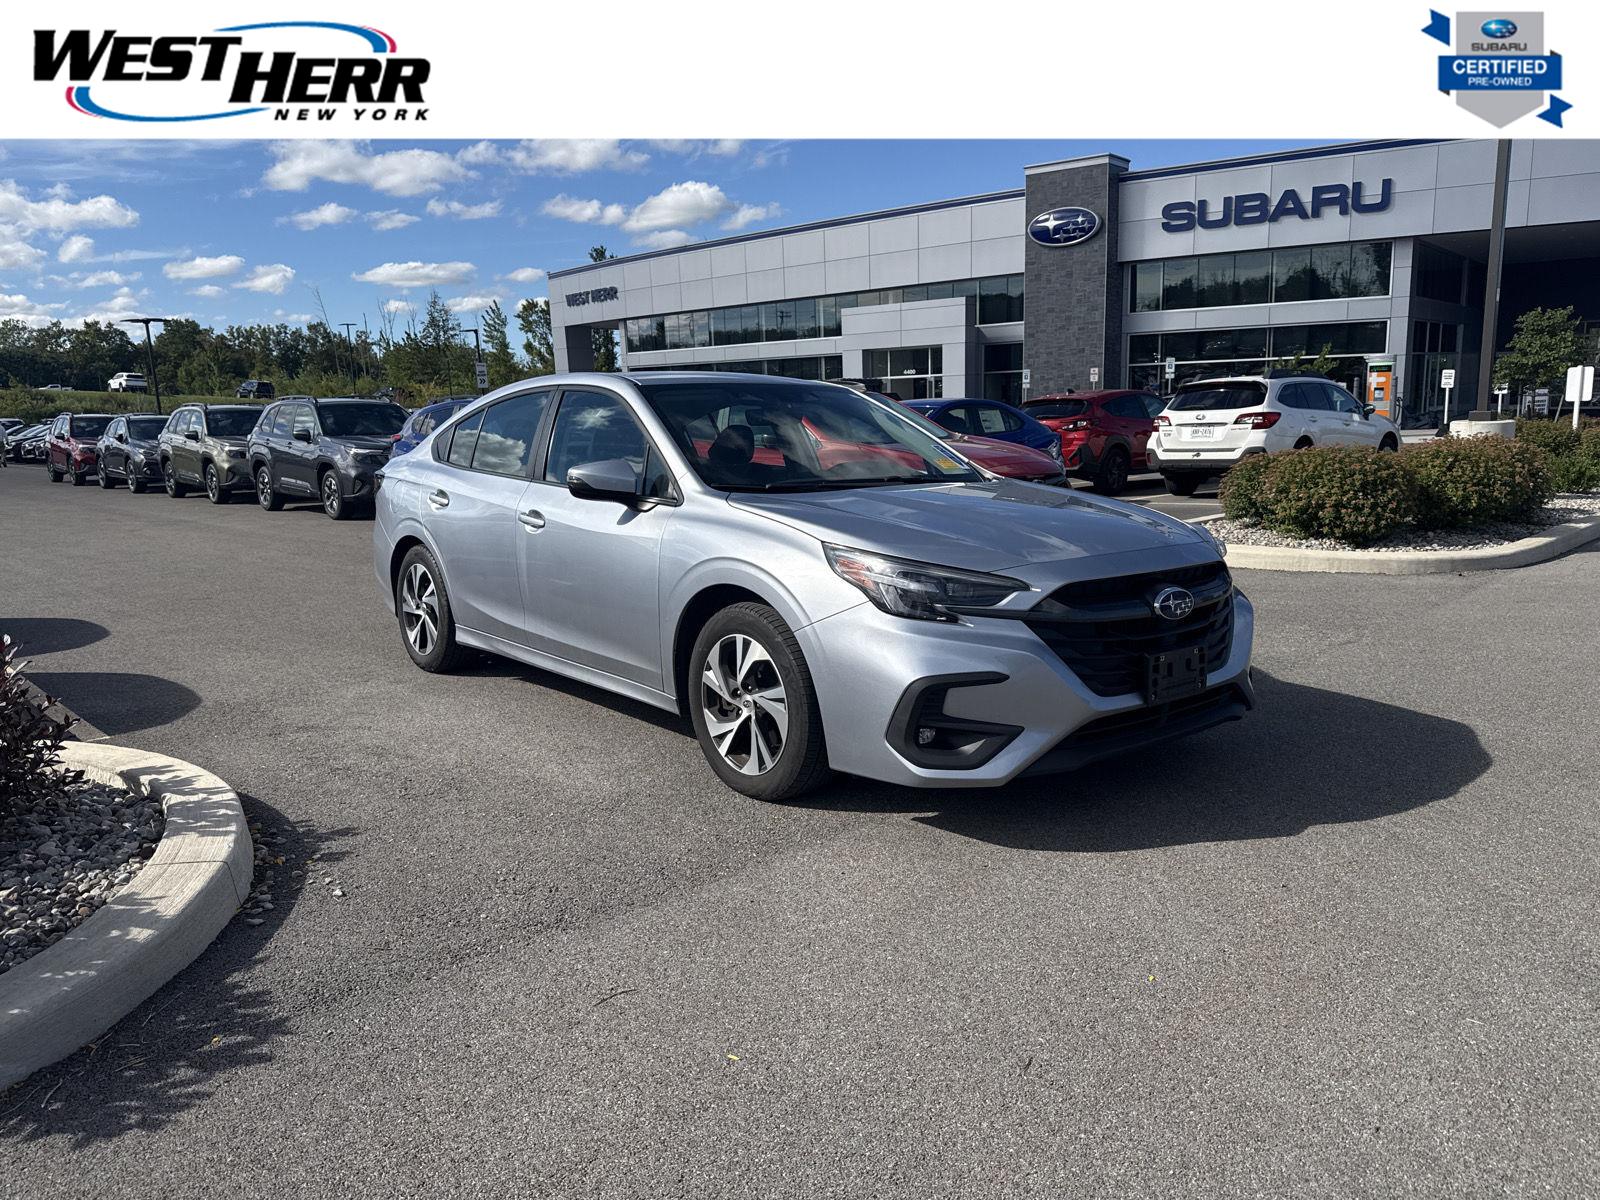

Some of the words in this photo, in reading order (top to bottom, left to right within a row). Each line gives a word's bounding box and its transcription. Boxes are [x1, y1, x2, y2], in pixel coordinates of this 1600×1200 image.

[1161, 178, 1392, 233] SUBARU
[565, 291, 590, 307] WEST
[590, 286, 619, 304] HERR
